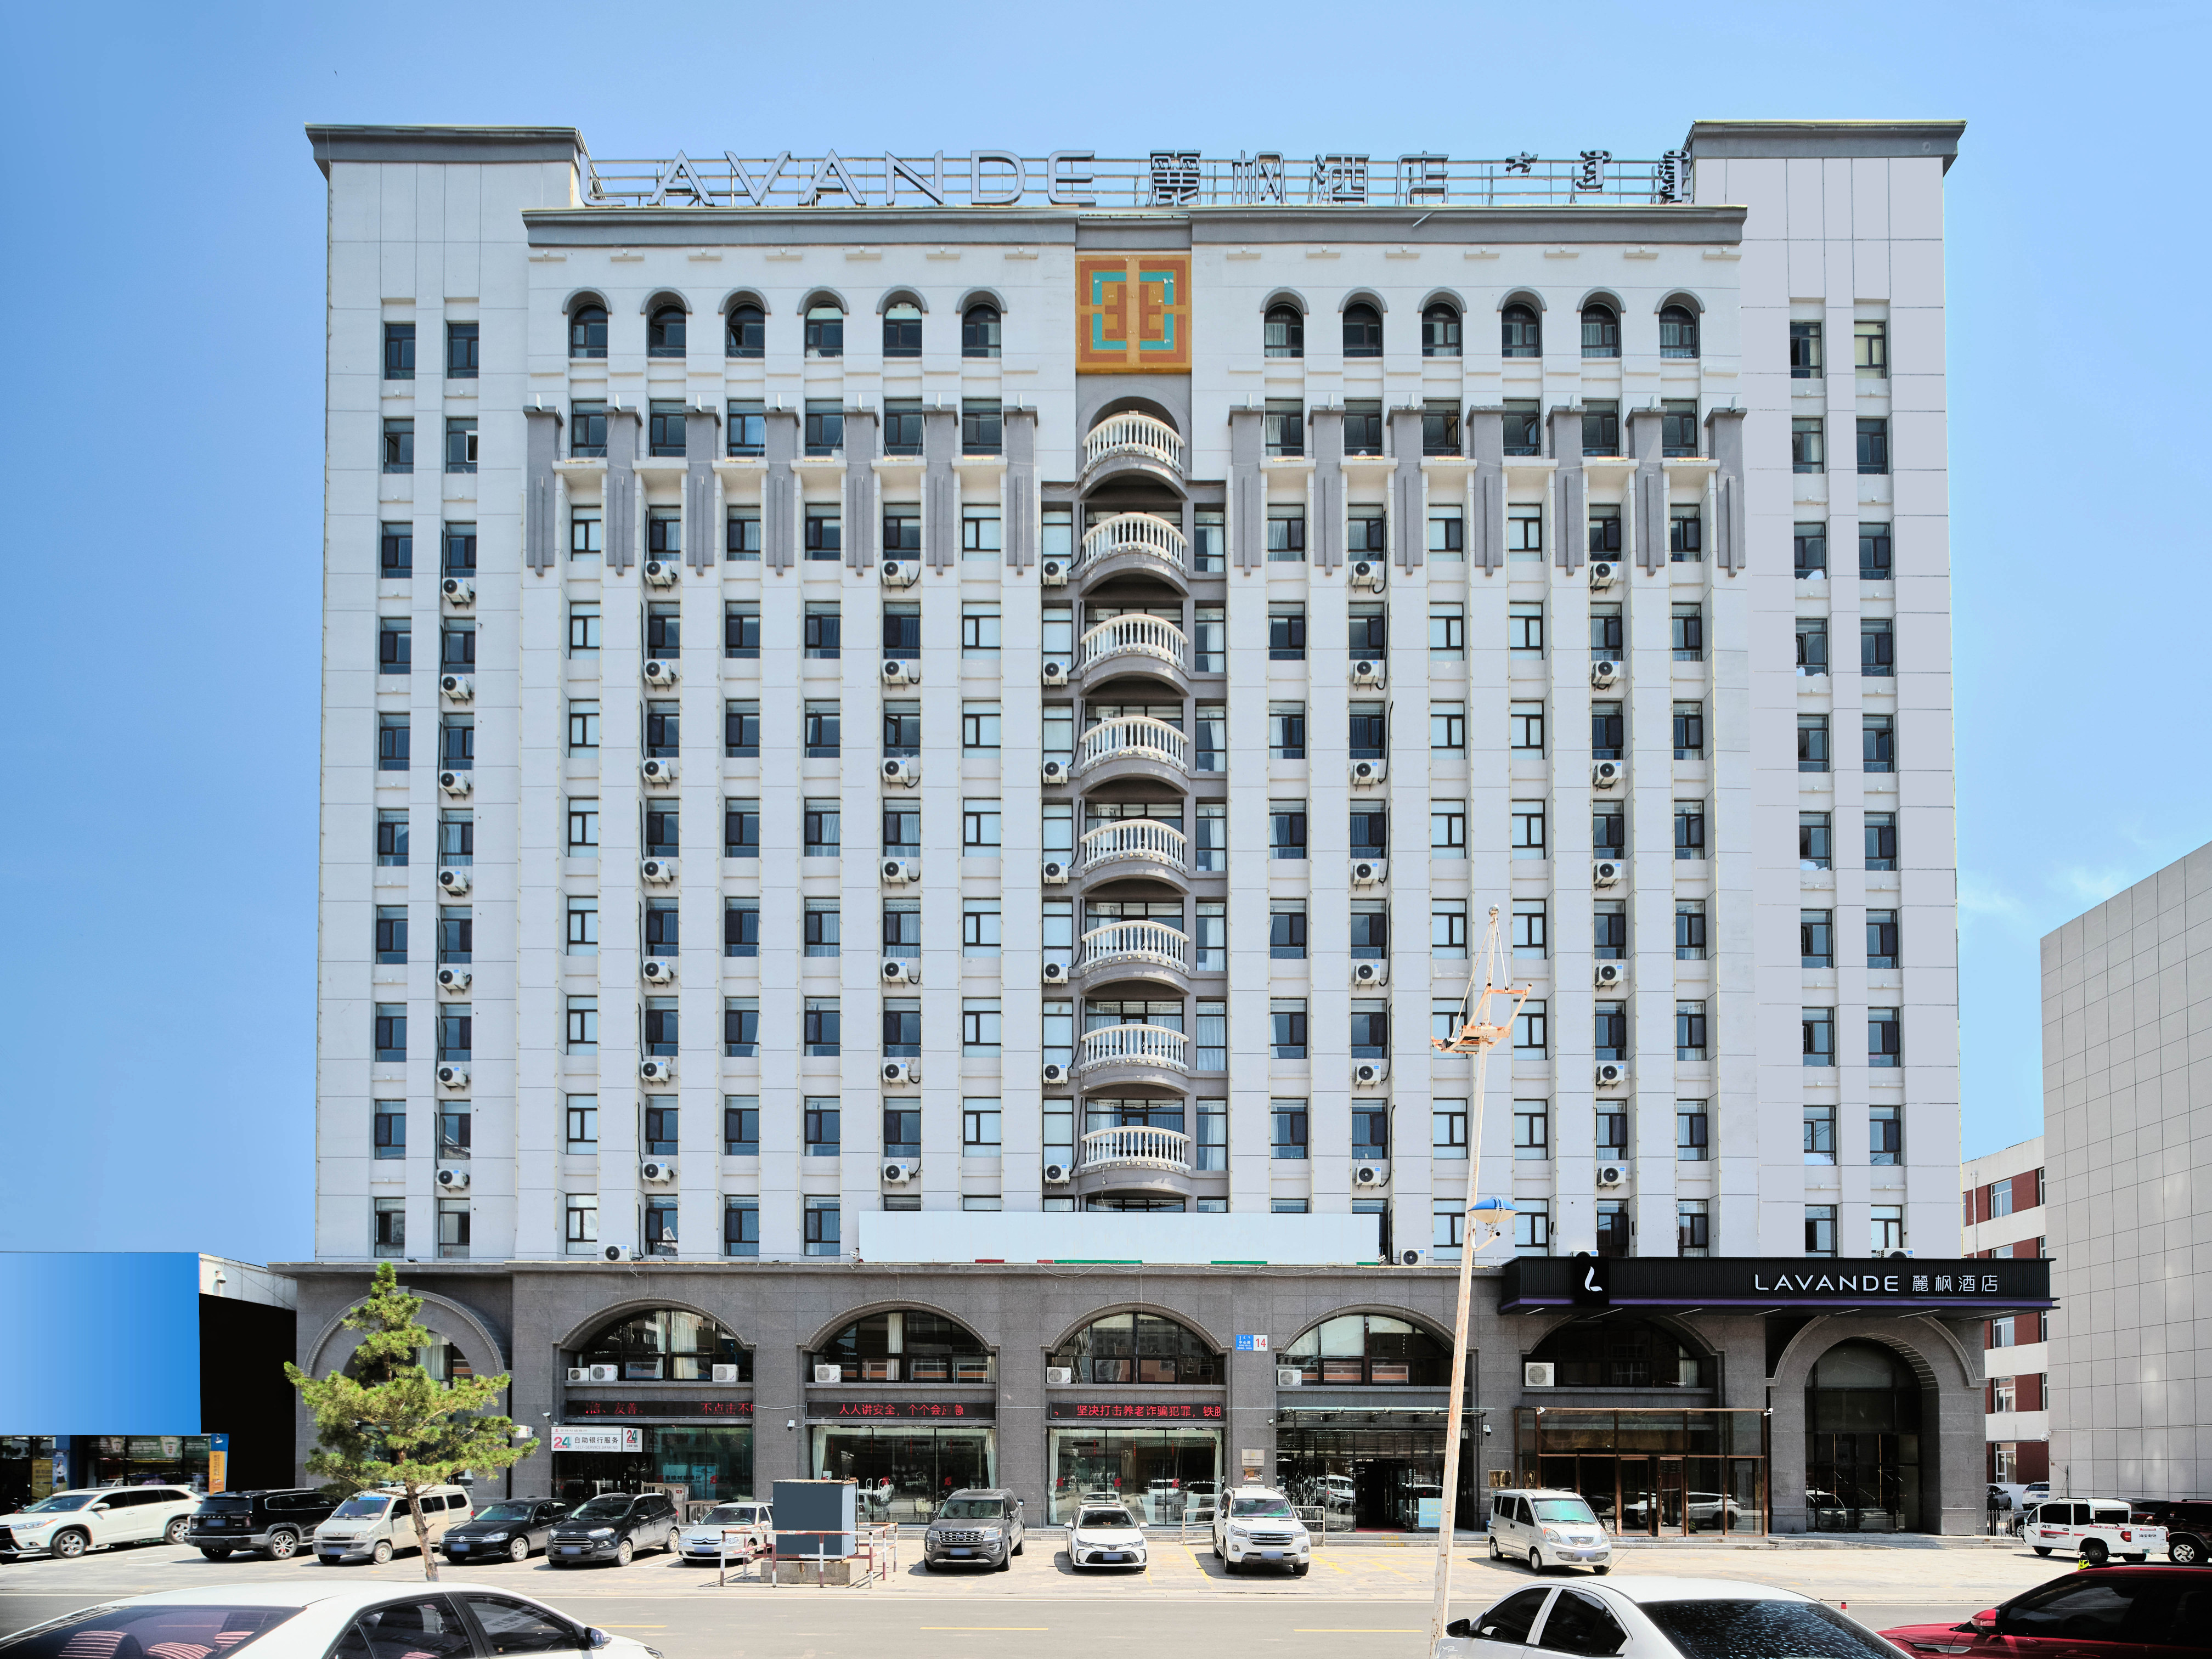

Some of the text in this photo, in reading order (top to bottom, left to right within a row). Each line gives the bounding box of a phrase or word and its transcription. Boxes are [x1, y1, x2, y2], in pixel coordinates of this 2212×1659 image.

[579, 149, 1096, 206] LAVANDE
[1146, 149, 1449, 206] 麗枫酒店
[1754, 1274, 1999, 1293] LAVANDE 麗枫酒店
[1256, 1338, 1266, 1347] 14
[701, 1402, 753, 1415] 不点击不
[554, 1436, 571, 1449] 24
[627, 1429, 637, 1443] 24
